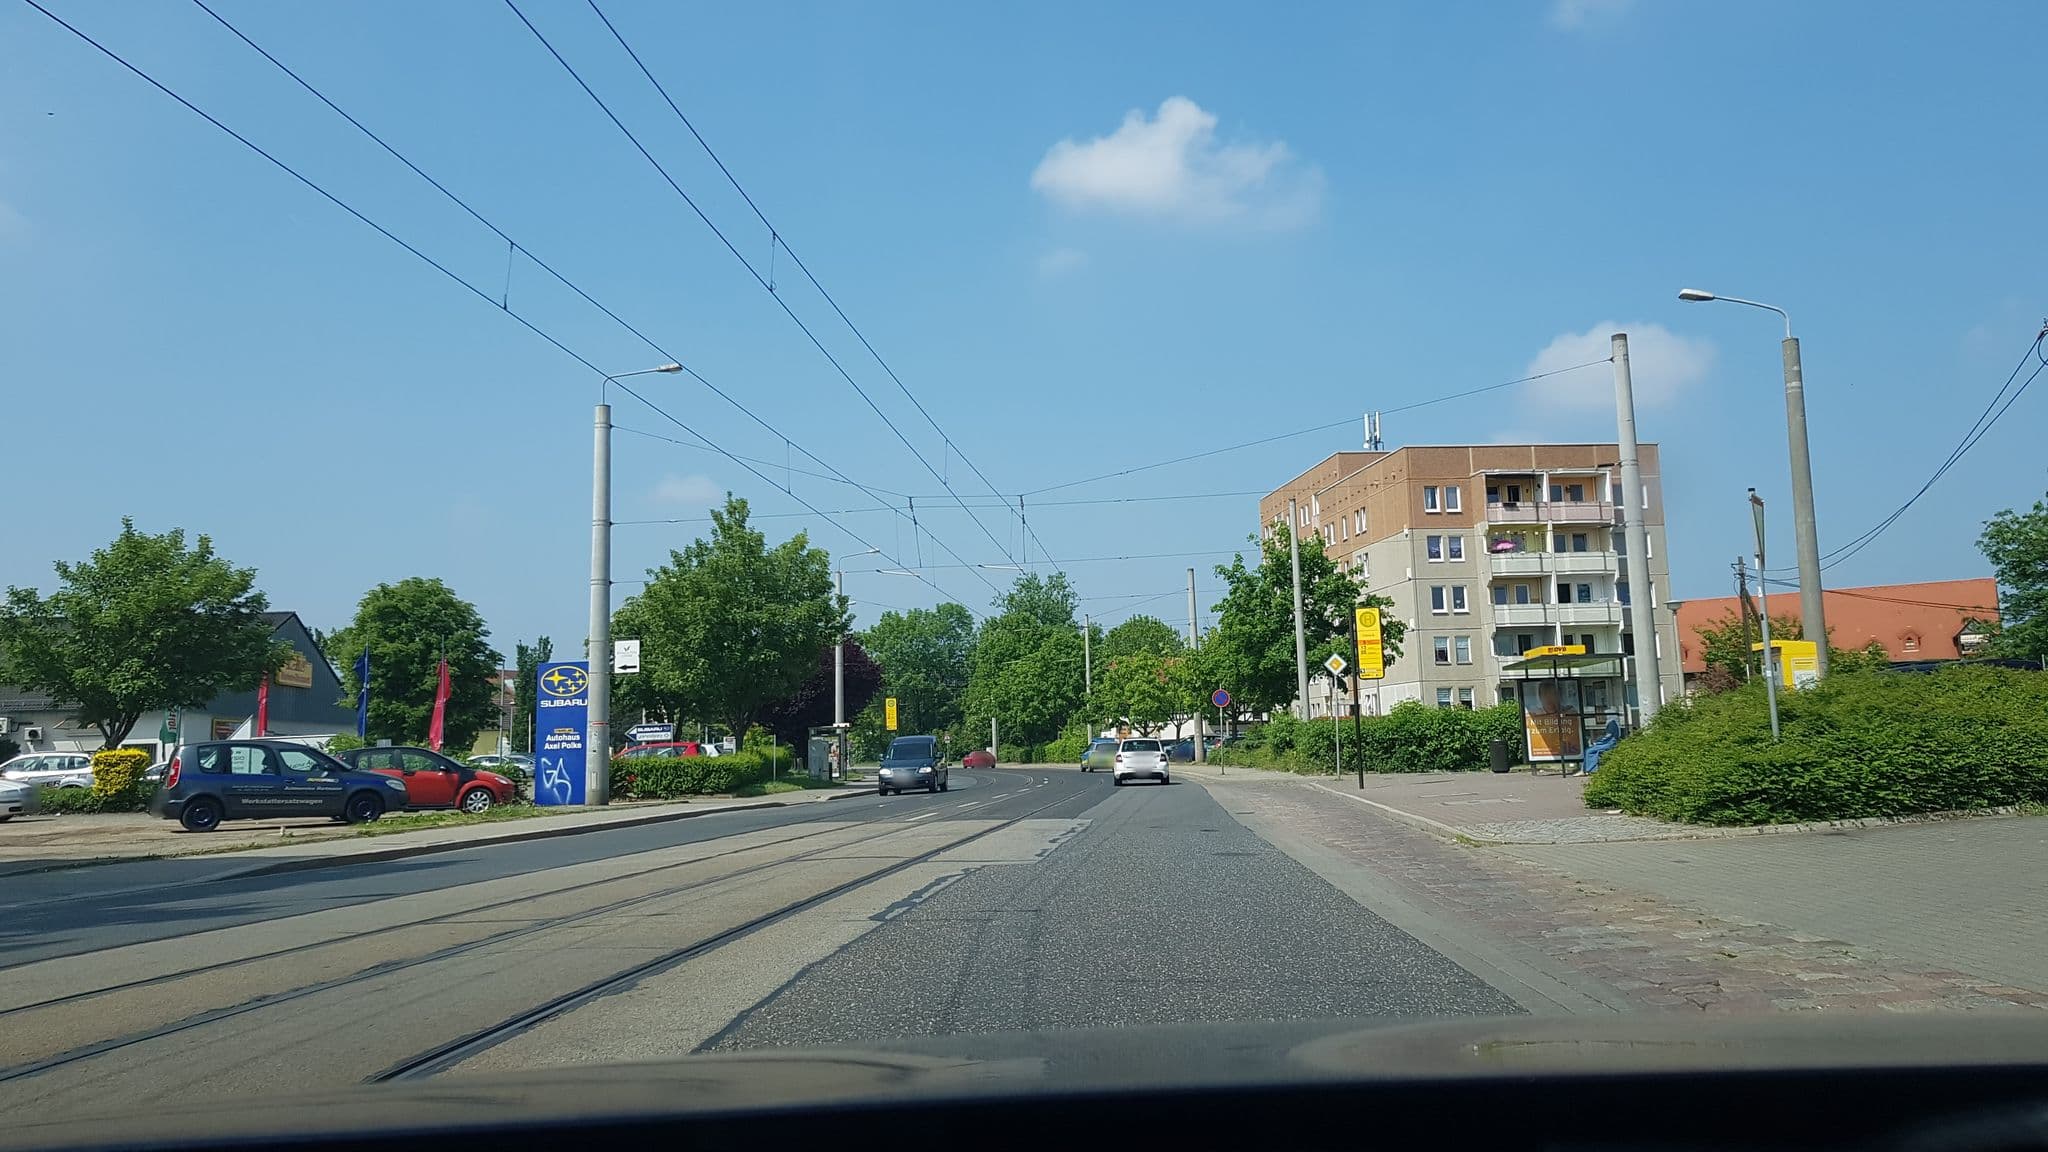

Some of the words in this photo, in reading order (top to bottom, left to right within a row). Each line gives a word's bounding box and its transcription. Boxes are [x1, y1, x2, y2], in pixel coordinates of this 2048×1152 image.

[540, 699, 588, 708] SUBARU
[544, 742, 559, 750] Axel
[561, 741, 582, 749] Polke
